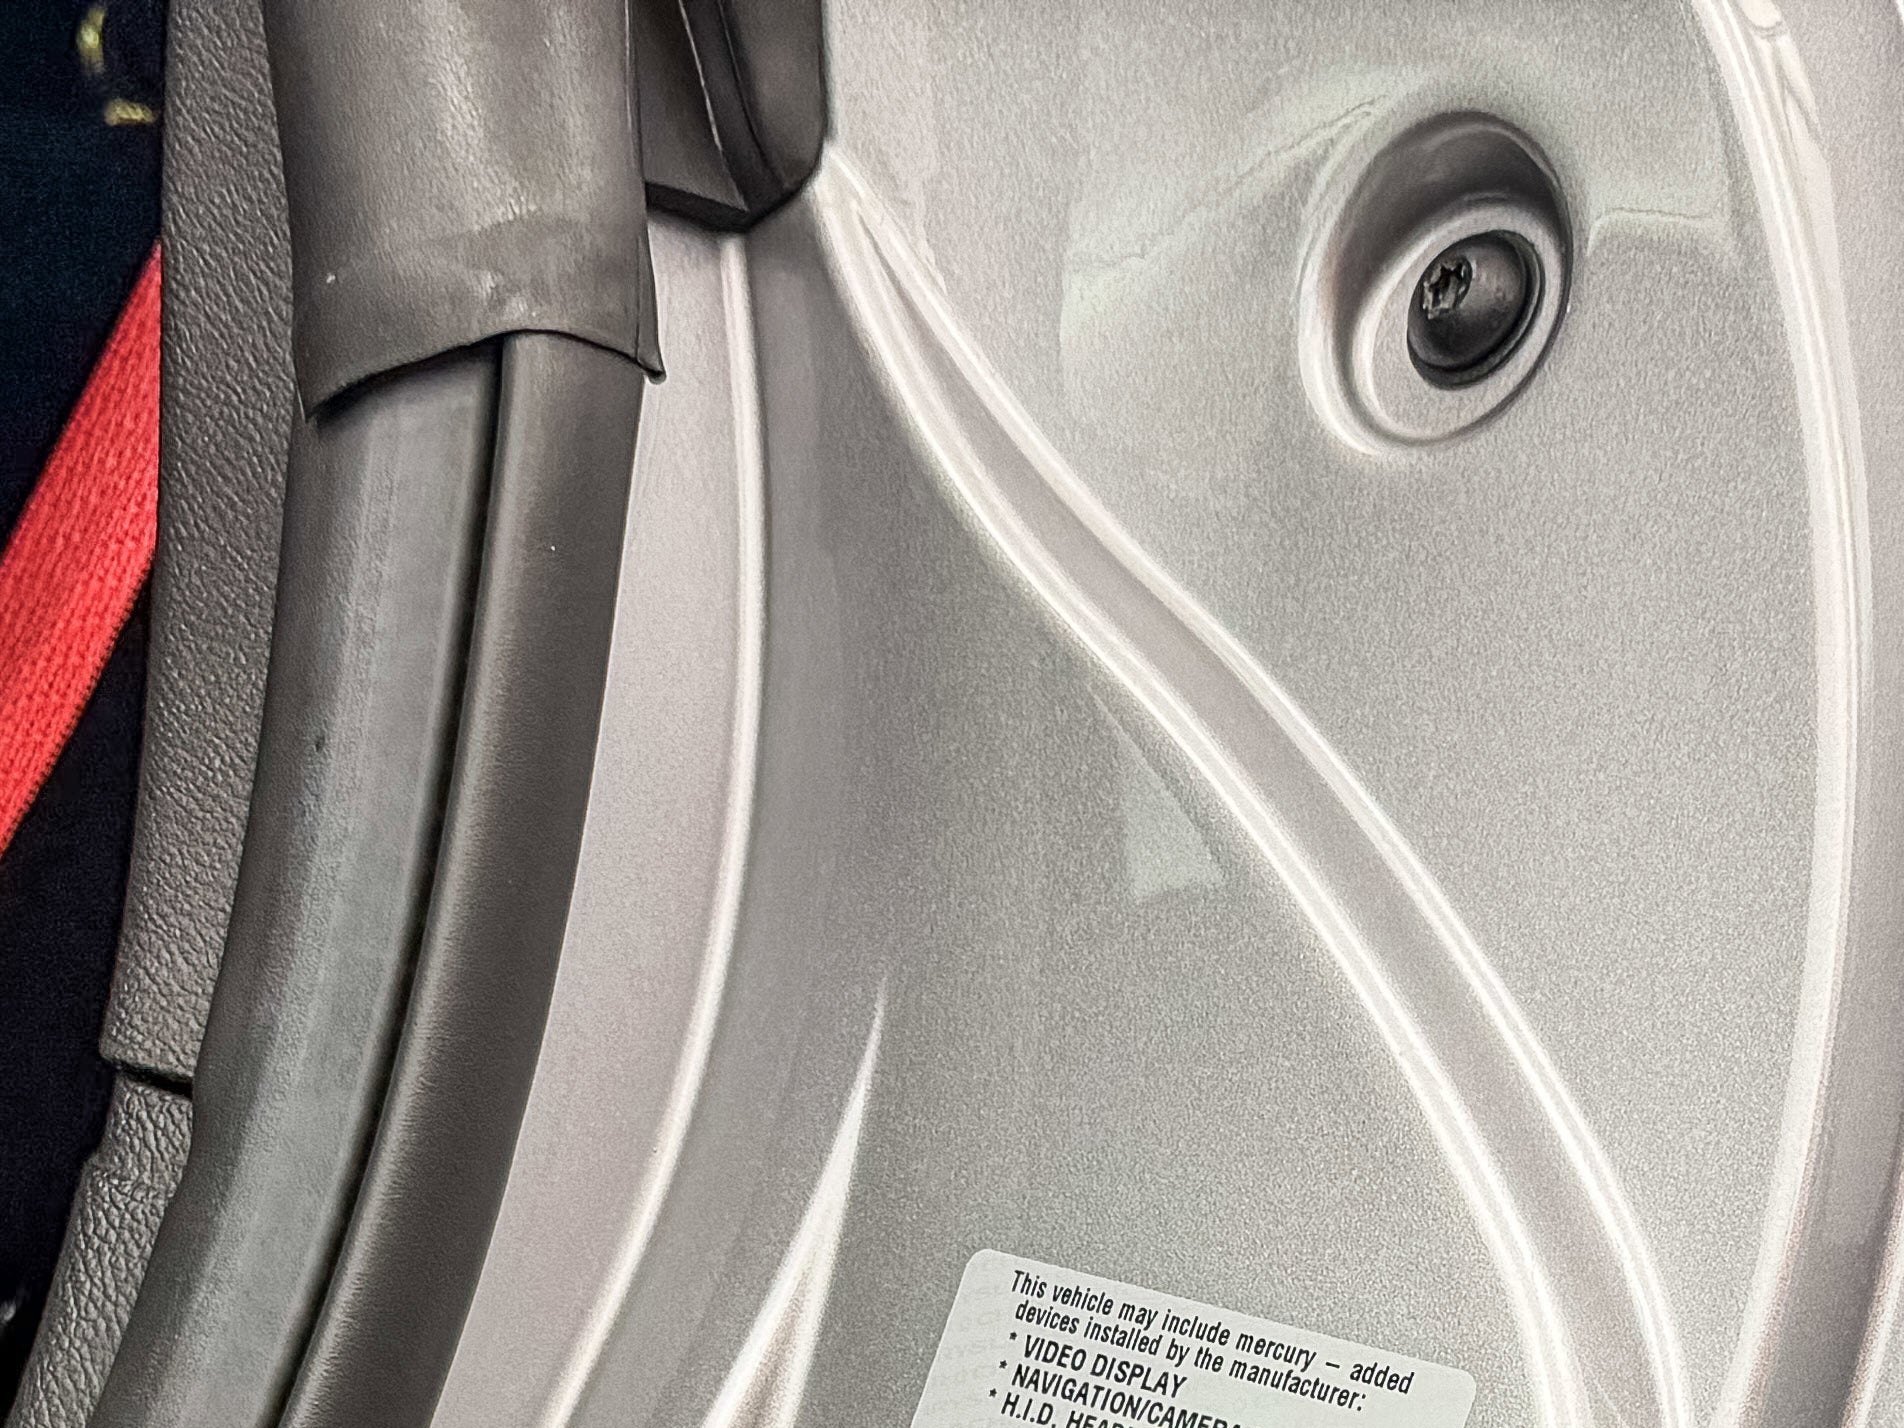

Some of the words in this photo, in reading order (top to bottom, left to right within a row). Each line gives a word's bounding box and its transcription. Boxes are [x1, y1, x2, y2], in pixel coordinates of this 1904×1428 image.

[1010, 1268, 1048, 1299] This
[1051, 1283, 1114, 1316] vehicle
[1116, 1301, 1159, 1332] may
[1160, 1307, 1231, 1347] include
[1234, 1331, 1317, 1373] mercury
[1348, 1360, 1415, 1395] added
[1014, 1298, 1080, 1335] devices
[1082, 1314, 1164, 1356] installed
[1164, 1336, 1191, 1368] by
[1192, 1344, 1224, 1373] the
[1227, 1358, 1367, 1412] manufacturer:
[1022, 1333, 1087, 1372] VIDEO
[1088, 1352, 1188, 1399] DISPLAY
